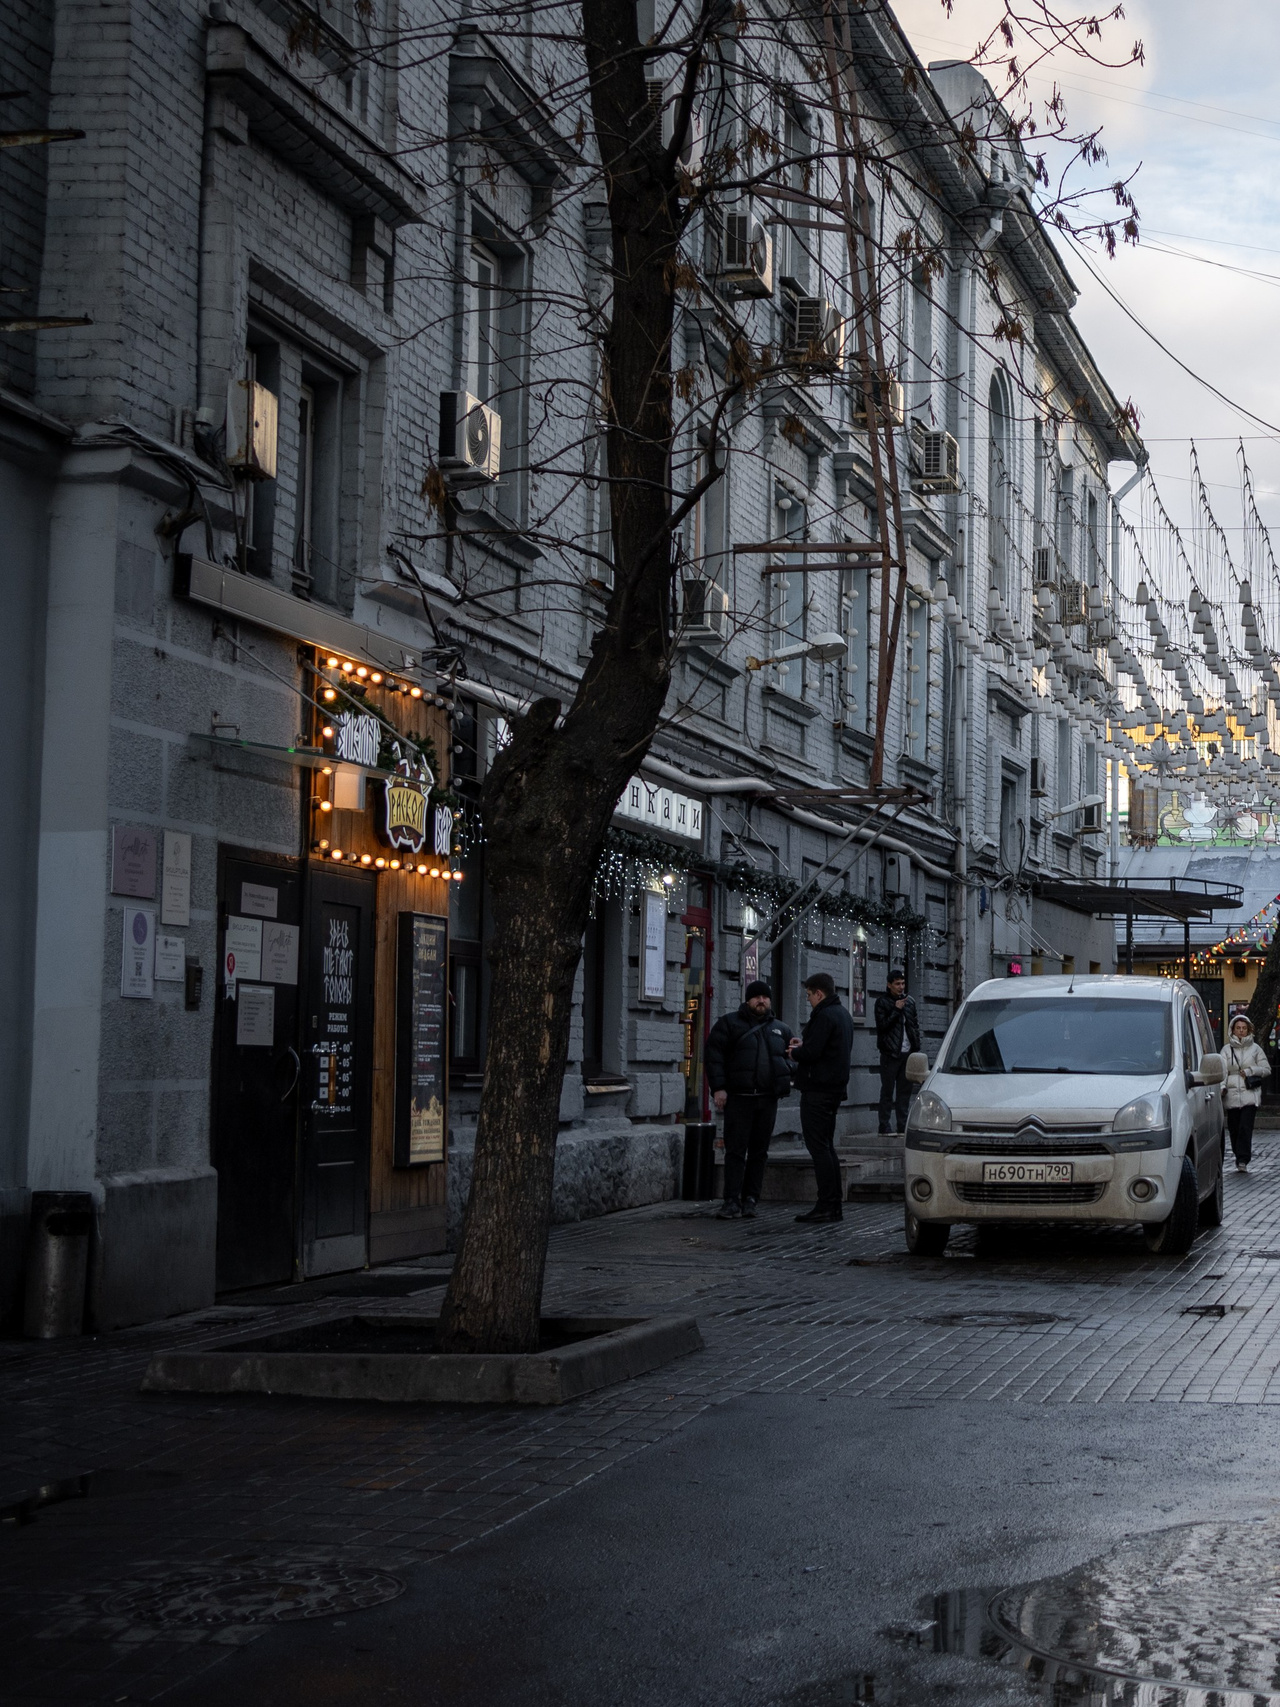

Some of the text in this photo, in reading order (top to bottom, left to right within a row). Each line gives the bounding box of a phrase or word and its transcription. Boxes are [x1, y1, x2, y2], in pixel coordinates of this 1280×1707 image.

[617, 785, 700, 830] нкали
[327, 1024, 348, 1033] РАБОТЫ
[989, 1165, 1068, 1180] Н690ТН 790
